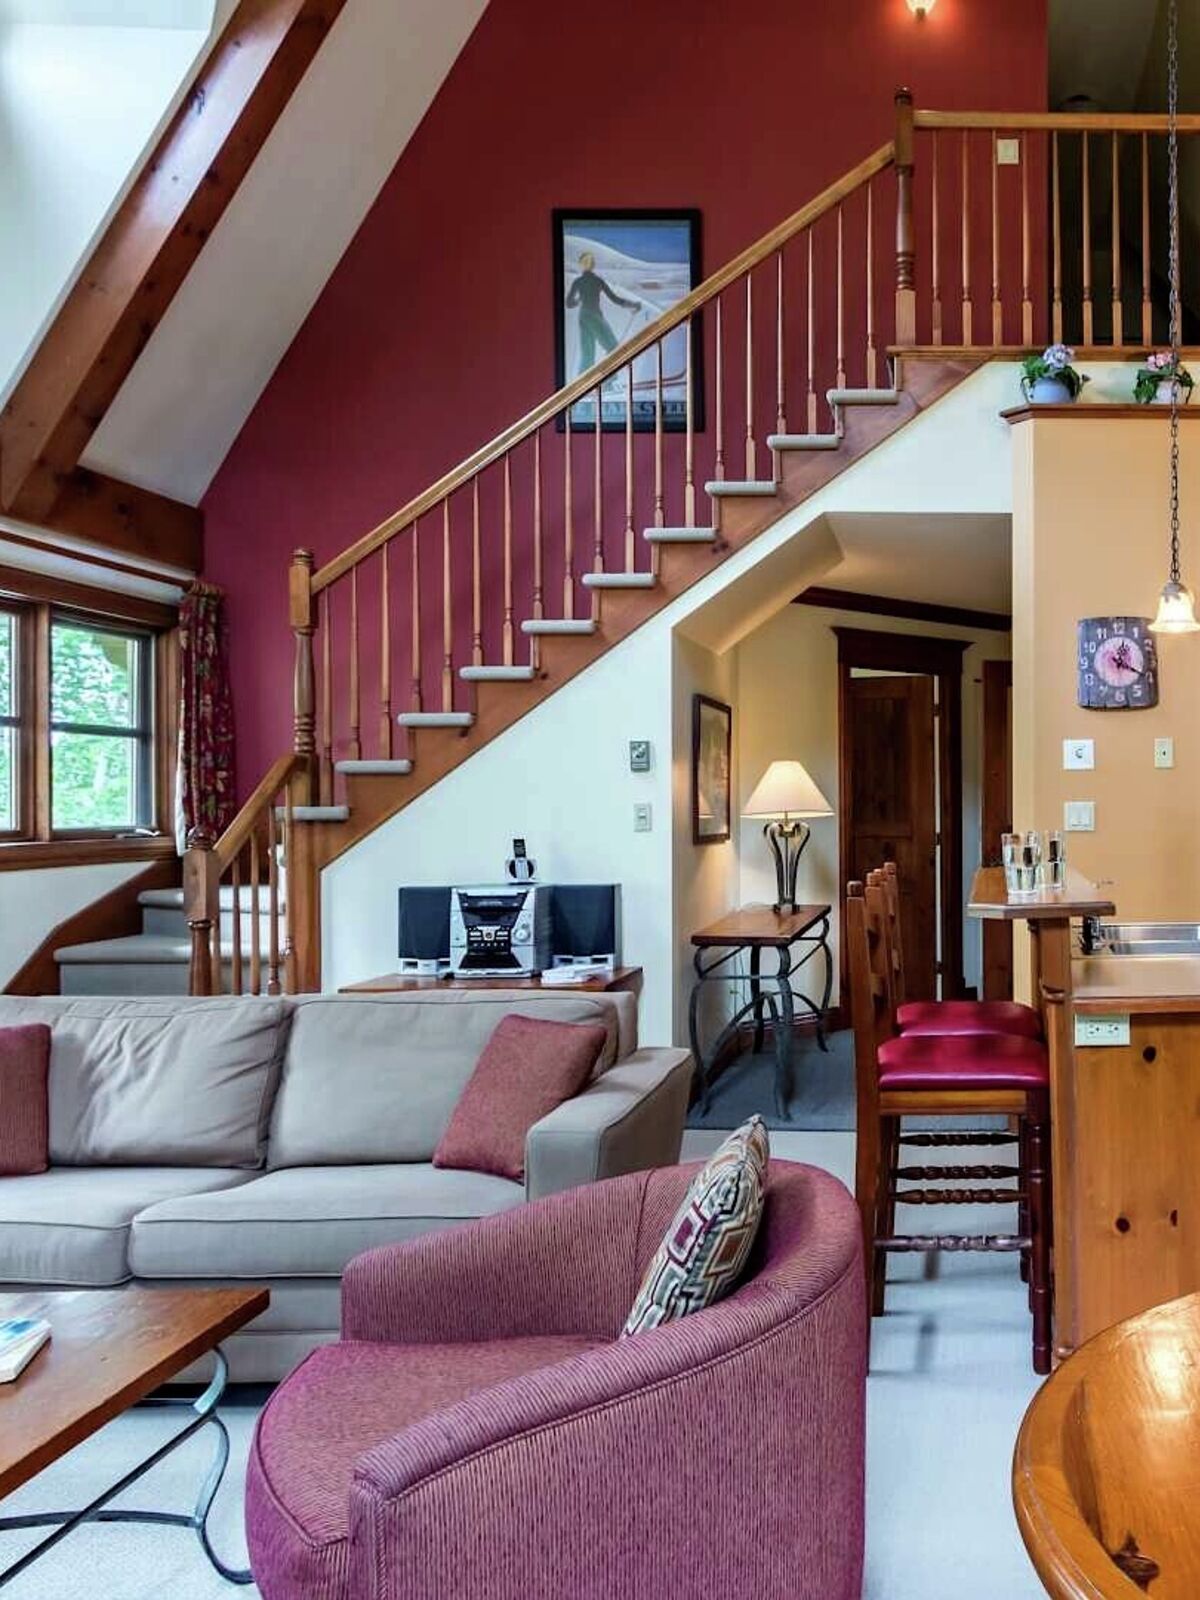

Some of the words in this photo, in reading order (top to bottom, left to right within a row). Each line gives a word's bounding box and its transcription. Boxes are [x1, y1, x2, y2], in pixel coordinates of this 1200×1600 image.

[1097, 627, 1108, 639] 11
[1113, 622, 1126, 635] 12
[1132, 626, 1139, 638] 1
[1084, 641, 1097, 653] 10
[1085, 673, 1094, 686] 8
[1115, 689, 1126, 702] 6
[1132, 683, 1142, 697] 5
